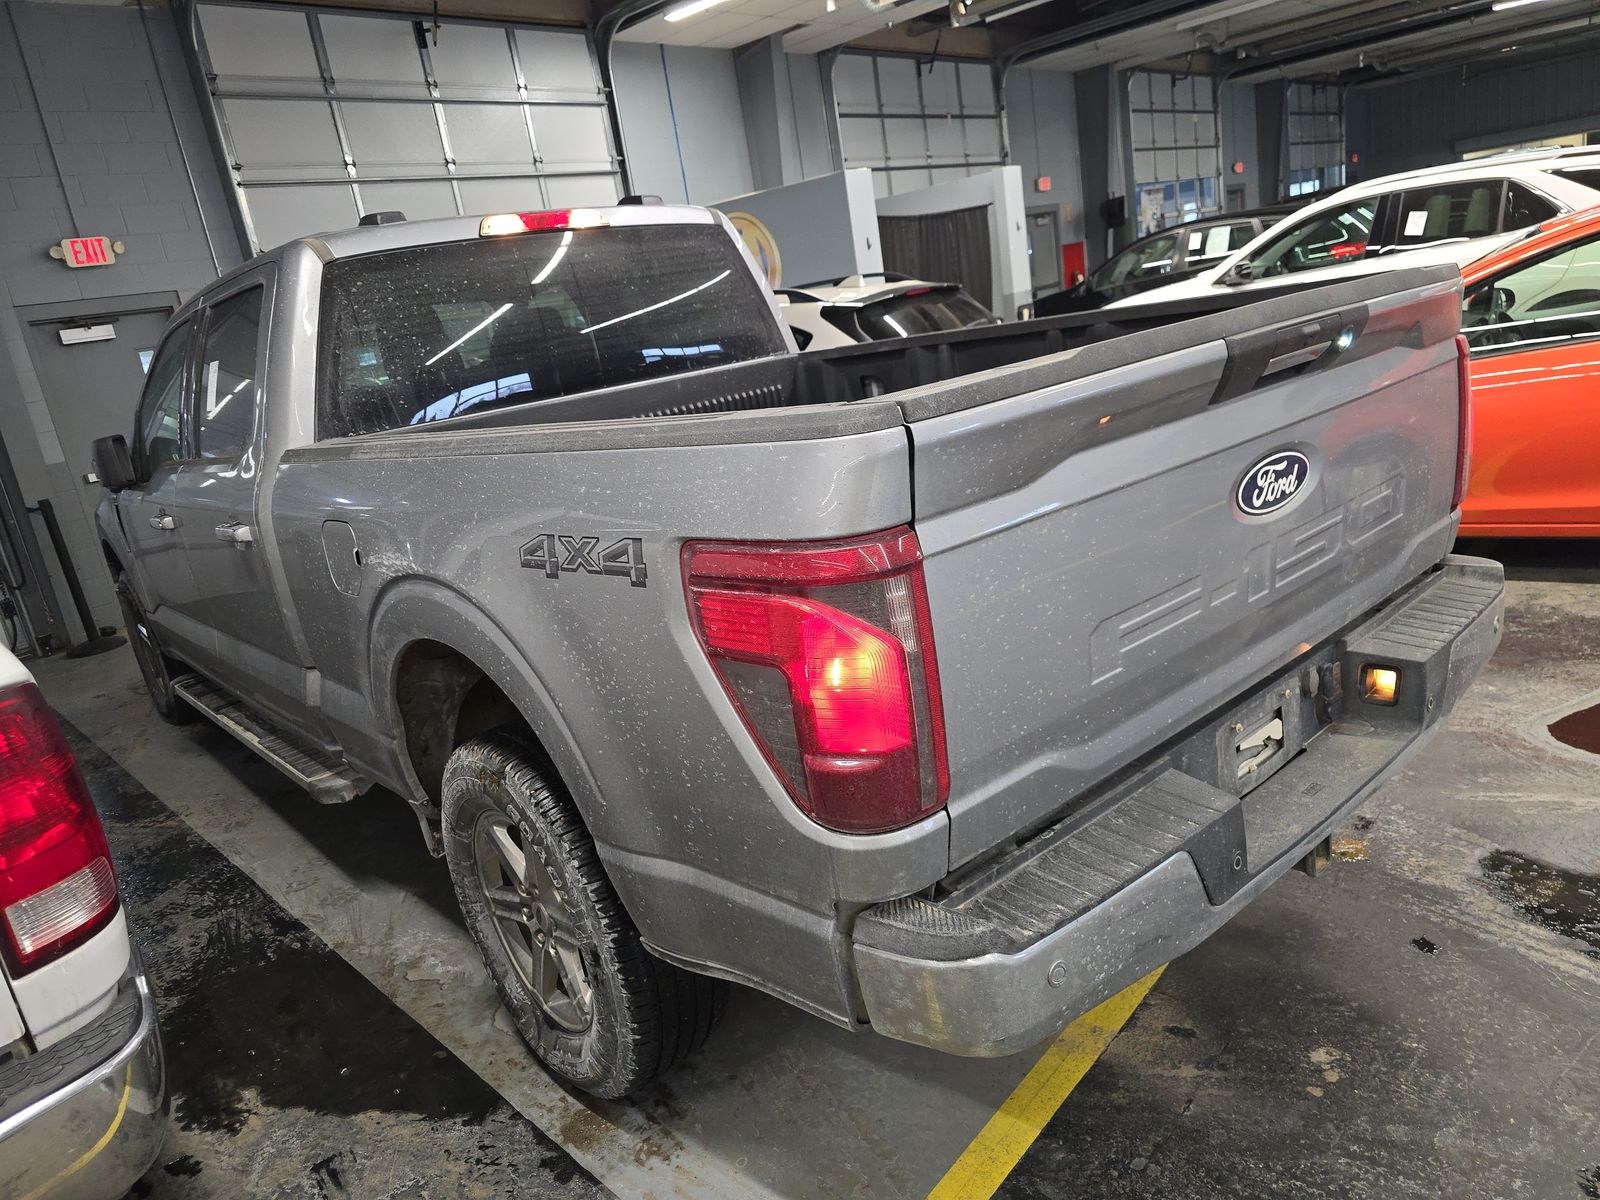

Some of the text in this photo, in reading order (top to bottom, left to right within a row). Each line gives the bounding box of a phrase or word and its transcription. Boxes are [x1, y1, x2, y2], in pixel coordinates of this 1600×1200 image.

[70, 238, 107, 264] EXIT
[1252, 460, 1299, 508] Ford
[1089, 474, 1405, 685] F-150
